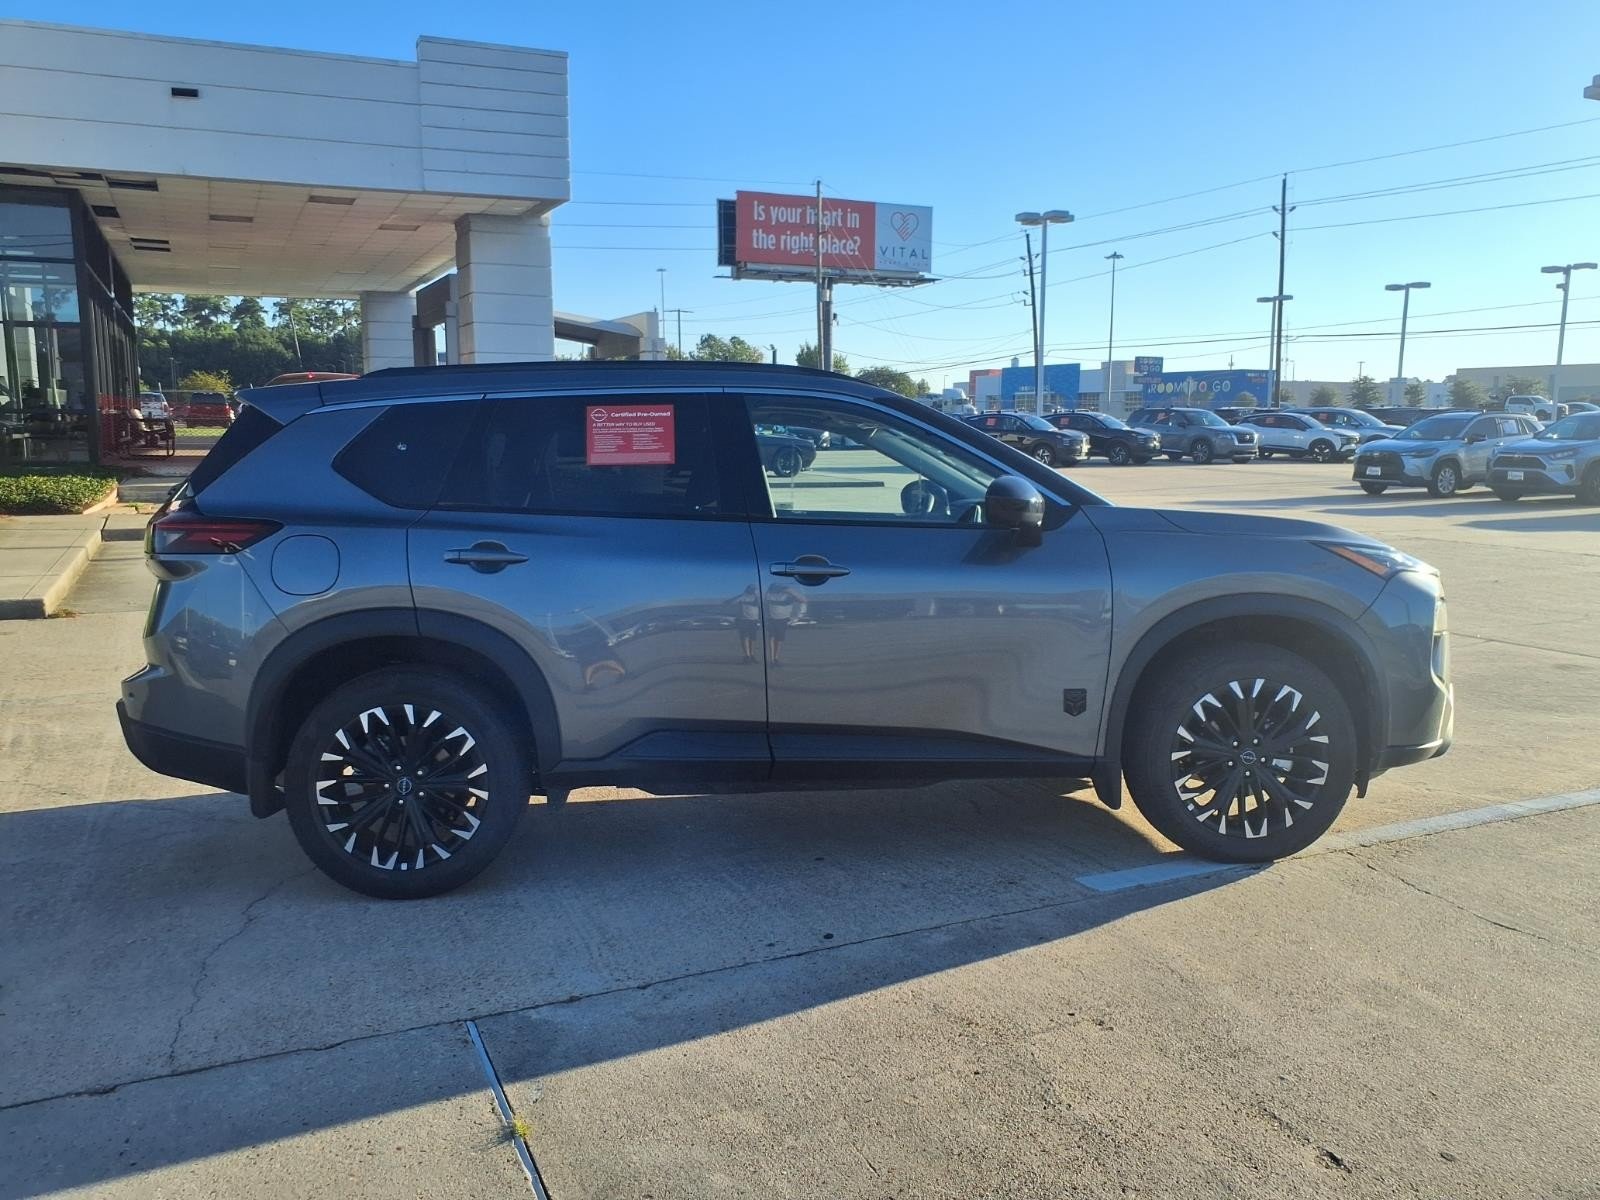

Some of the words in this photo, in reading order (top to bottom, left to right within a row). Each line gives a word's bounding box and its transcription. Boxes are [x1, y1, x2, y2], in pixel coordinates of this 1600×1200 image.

[754, 200, 765, 221] Is
[770, 205, 802, 225] your
[806, 205, 843, 227] hart
[847, 208, 860, 228] in
[752, 228, 776, 249] the
[780, 230, 815, 255] right
[819, 234, 861, 256] place?
[880, 245, 928, 260] VITAL
[1151, 381, 1189, 394] ROOM
[1212, 380, 1231, 393] GO
